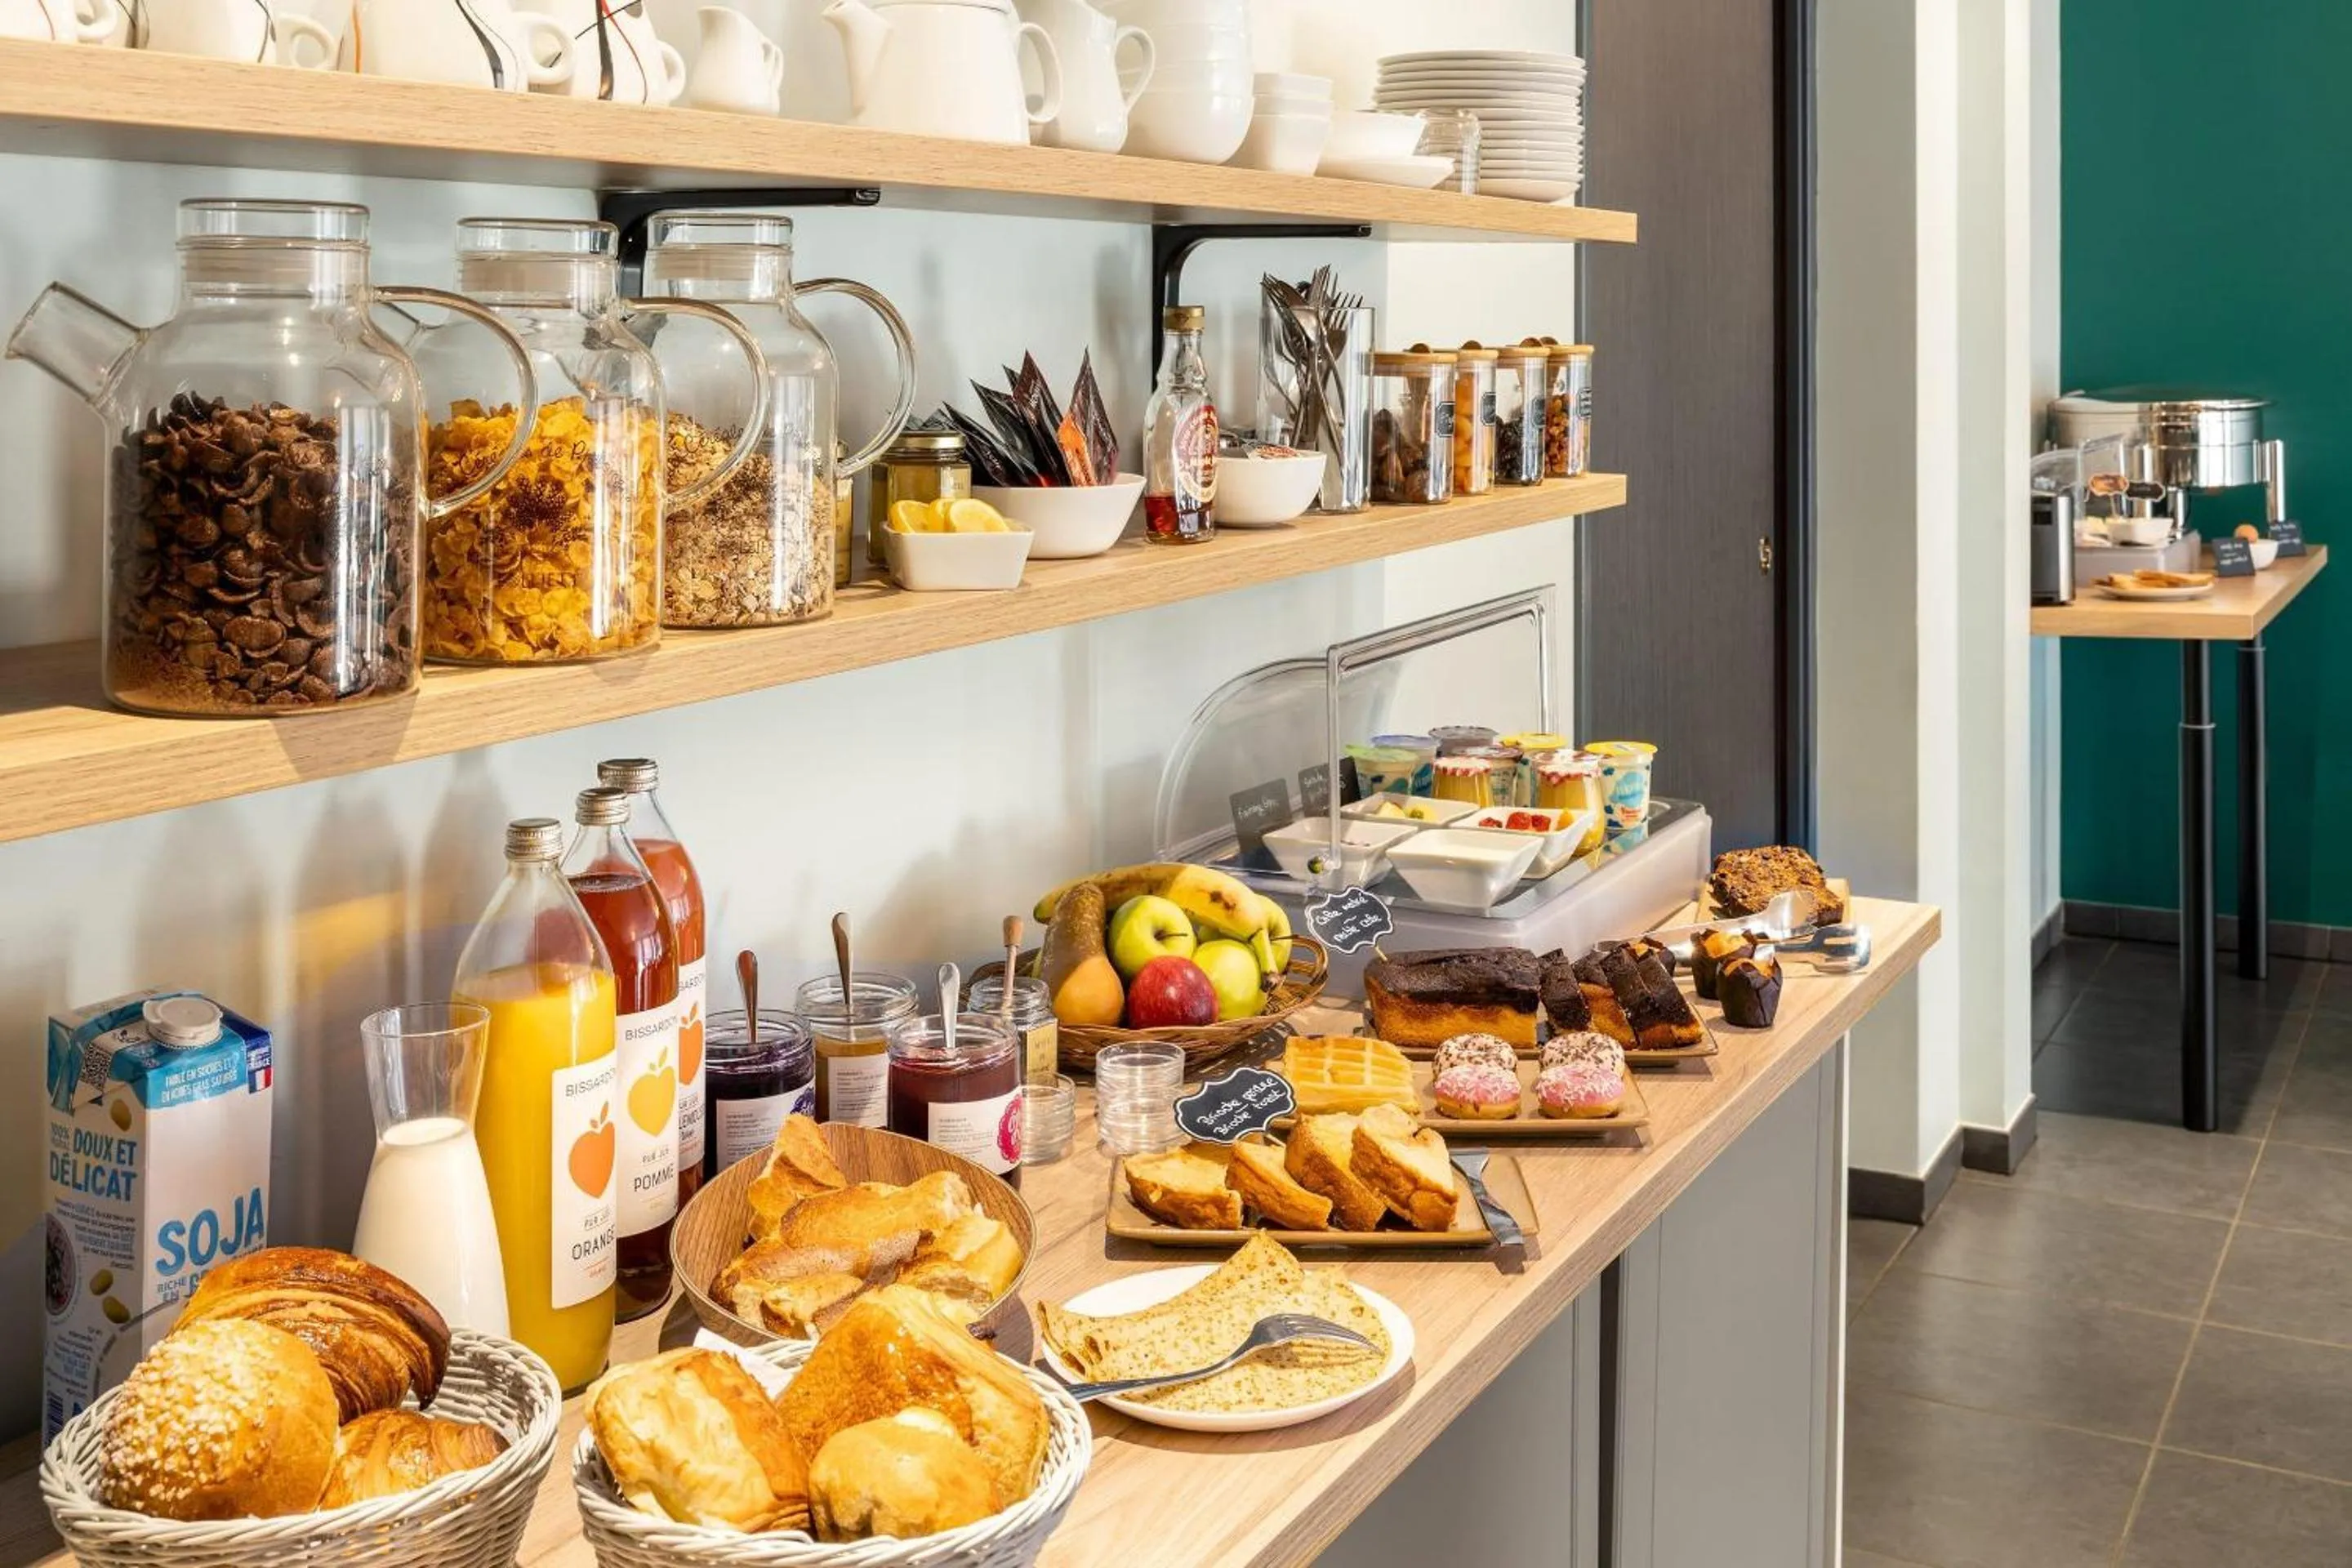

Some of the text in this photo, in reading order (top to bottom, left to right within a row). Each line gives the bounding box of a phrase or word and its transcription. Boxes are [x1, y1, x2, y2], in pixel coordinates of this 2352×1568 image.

[74, 1128, 114, 1162] DOUX
[117, 1138, 137, 1166] ET
[634, 1162, 675, 1192] POMME
[155, 1187, 265, 1276] SOJA
